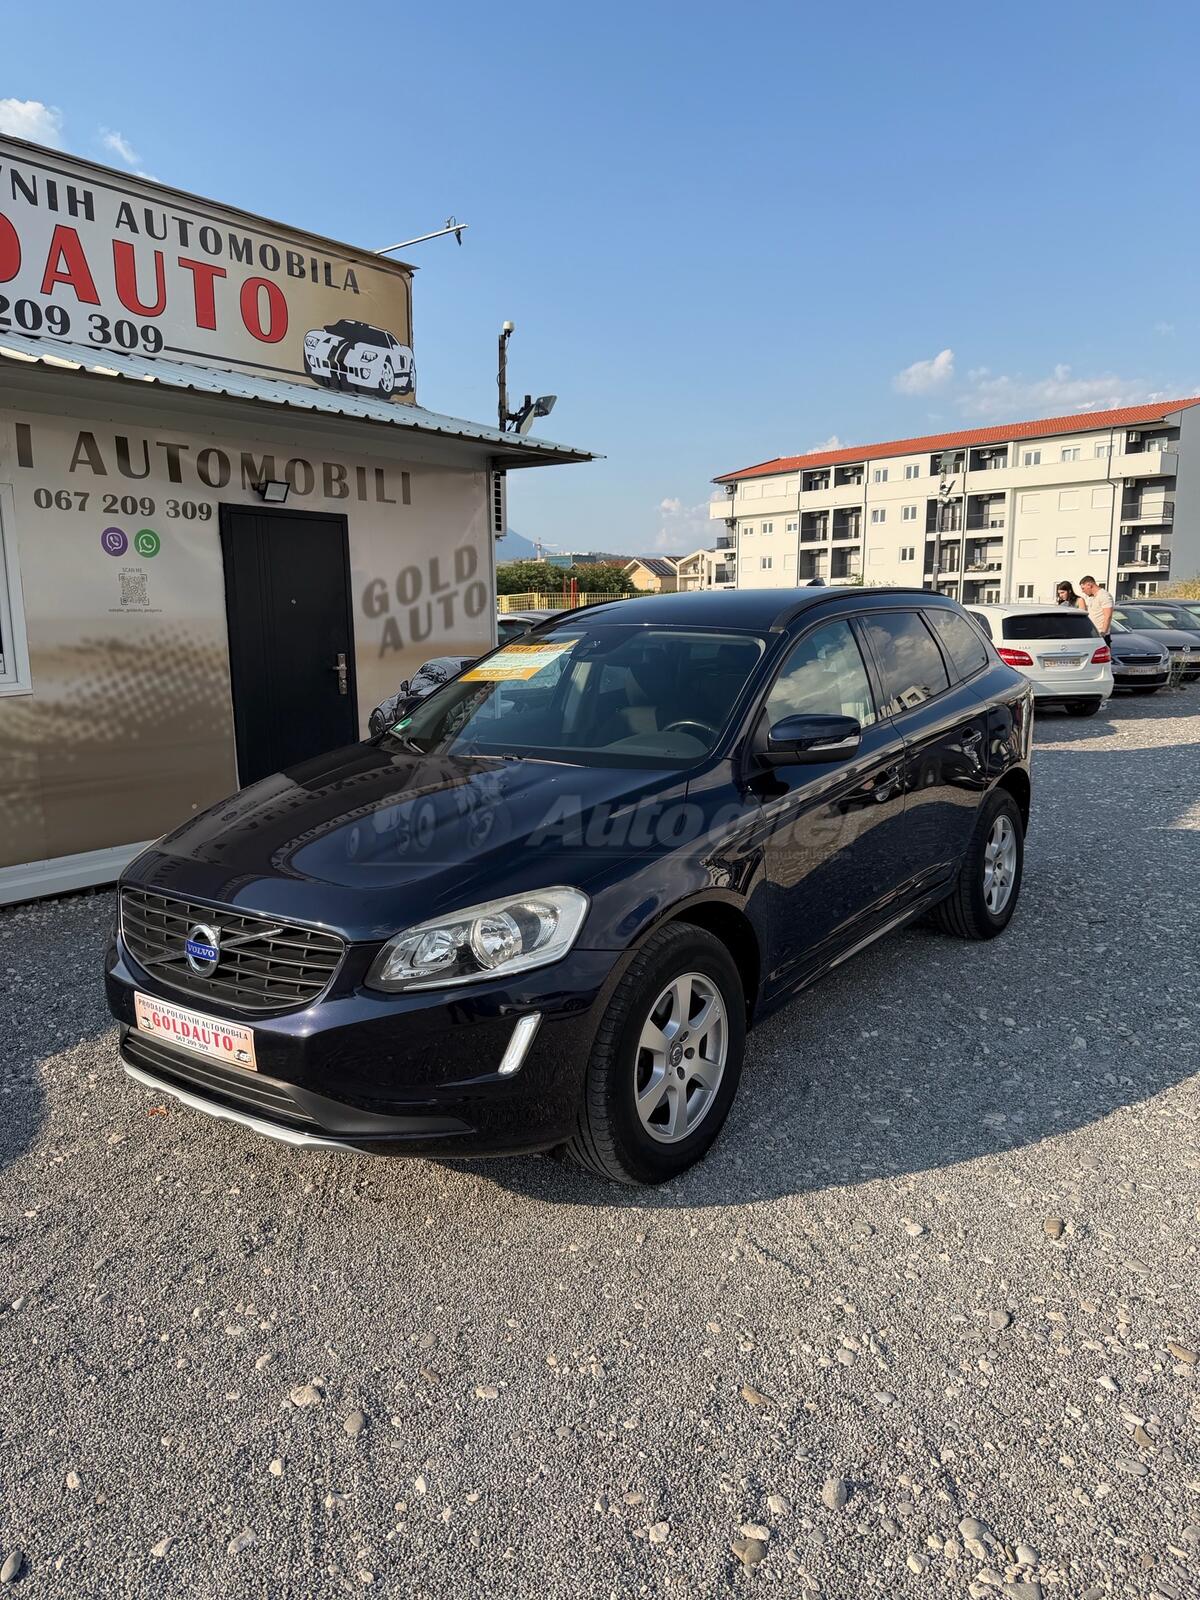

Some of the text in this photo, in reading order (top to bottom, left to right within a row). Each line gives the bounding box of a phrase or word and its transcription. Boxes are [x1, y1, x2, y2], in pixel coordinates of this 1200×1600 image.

[0, 165, 360, 294] NIH AUTOMOBILA
[88, 313, 164, 353] 309
[69, 430, 411, 505] AUTOMOBILI
[33, 488, 213, 521] 067 209 309
[361, 544, 478, 620] GOLD
[378, 581, 487, 659] AUTO
[187, 944, 215, 957] VOLVO
[138, 999, 248, 1040] PRODAJA POLOVNIH AUTOMOBILA
[152, 1012, 233, 1052] GOLDAUTO
